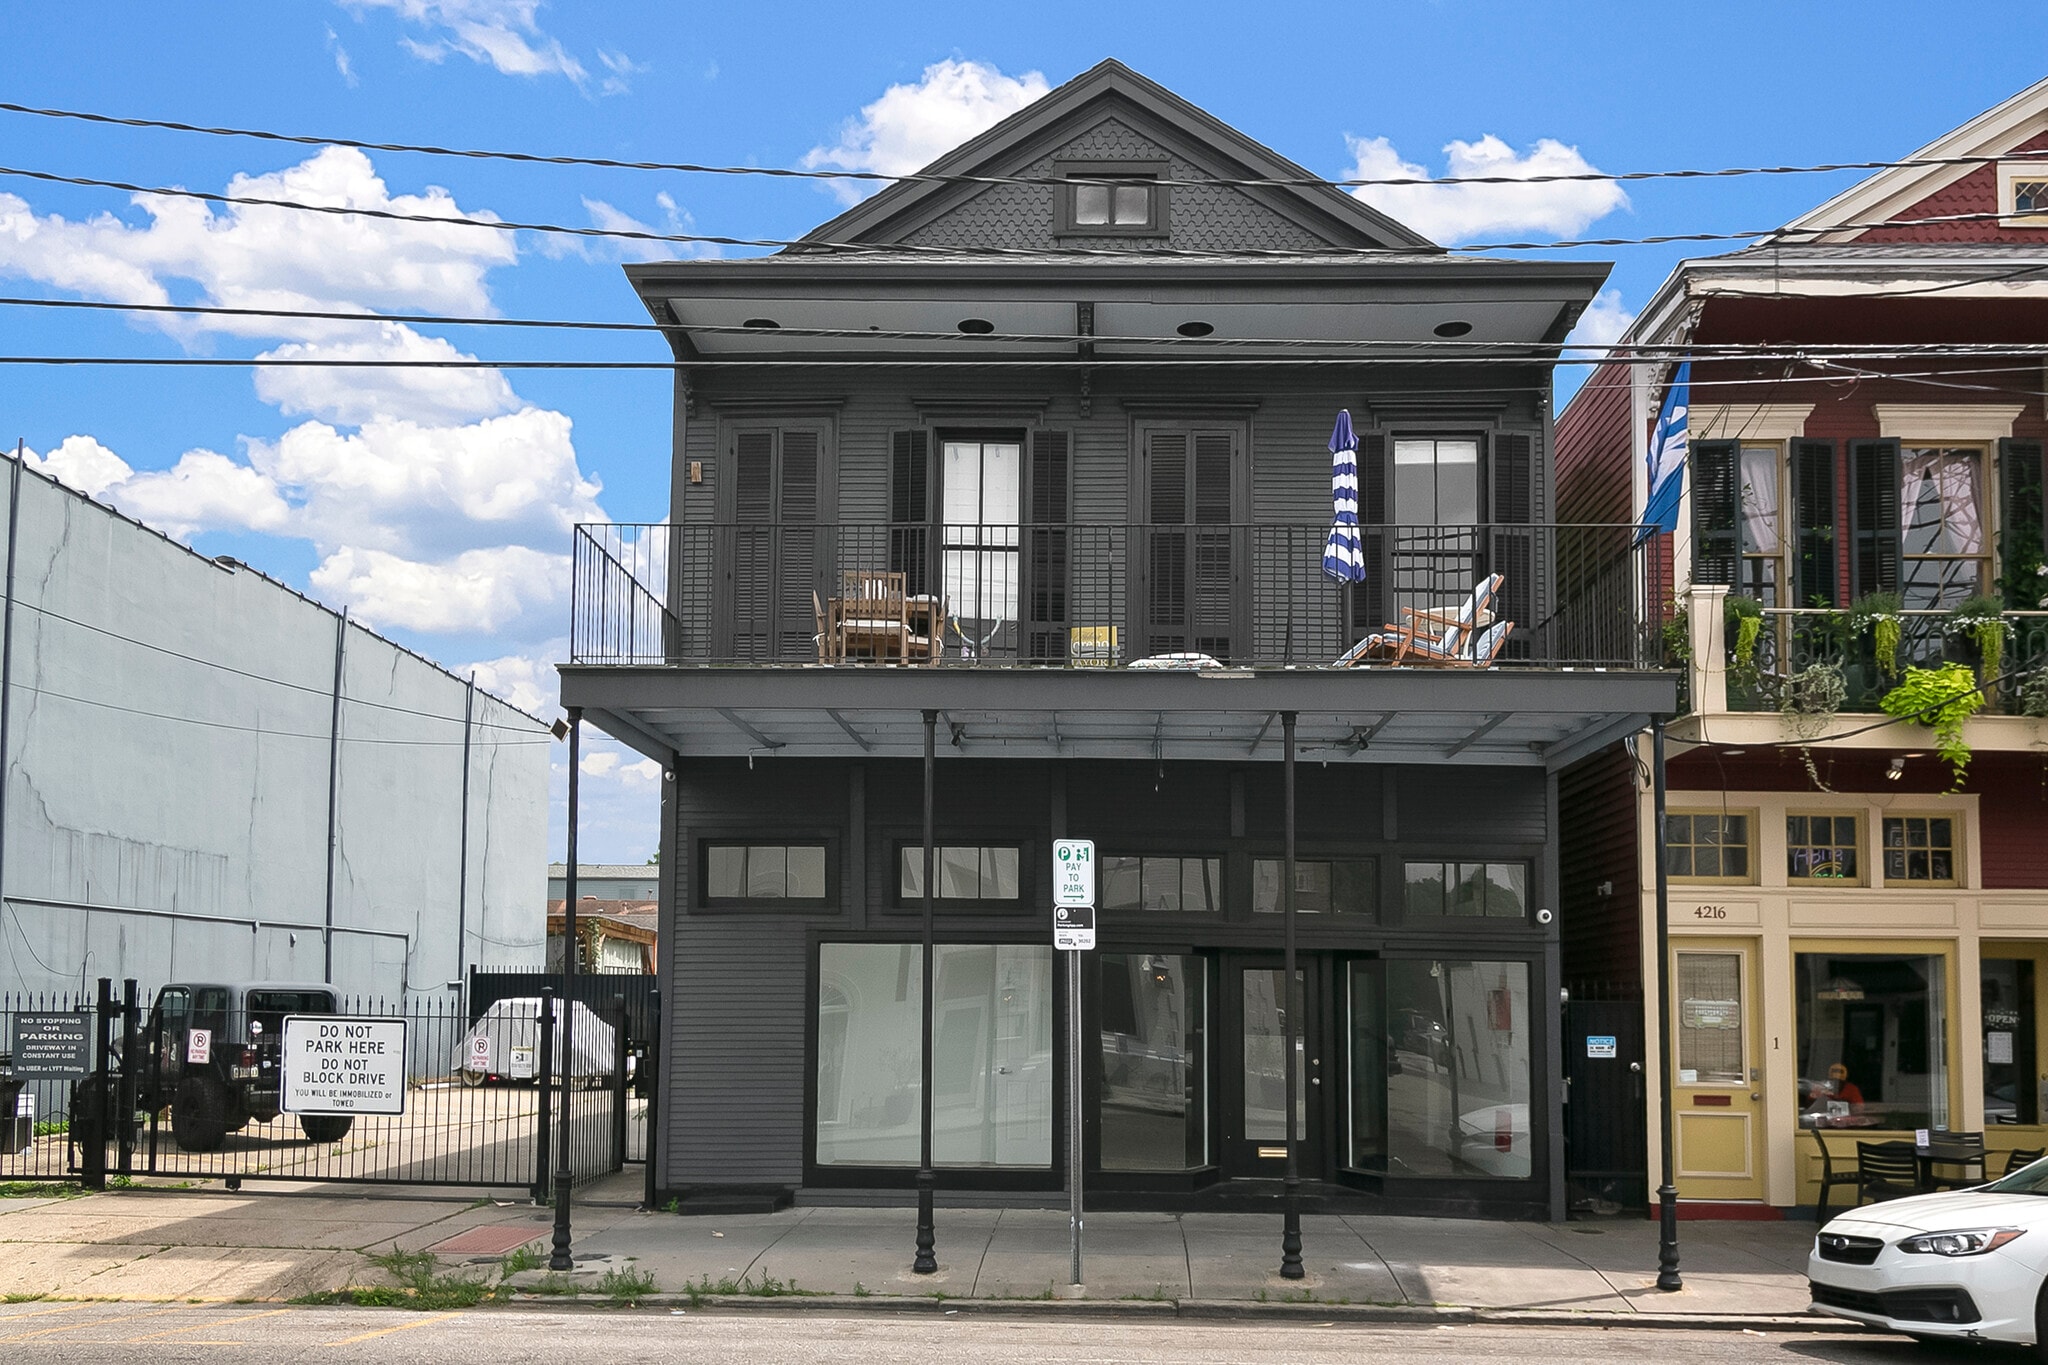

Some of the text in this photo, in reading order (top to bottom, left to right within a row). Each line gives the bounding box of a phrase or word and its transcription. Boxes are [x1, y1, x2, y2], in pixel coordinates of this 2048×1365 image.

[1066, 863, 1081, 871] PAY
[1068, 873, 1079, 882] TO
[1063, 884, 1085, 893] PARK
[1694, 905, 1726, 919] 4216
[1988, 1014, 2017, 1024] OPEN
[320, 1025, 373, 1038] DO NOT
[305, 1040, 385, 1054] PARK HERE
[321, 1058, 369, 1071] DO NOT
[303, 1071, 386, 1085] BLOCK DRIVE
[295, 1088, 309, 1097] YOU
[311, 1089, 326, 1097] WILL
[328, 1090, 338, 1098] BE
[339, 1090, 383, 1099] IMMOBILIZED
[332, 1099, 355, 1108] TOWED
